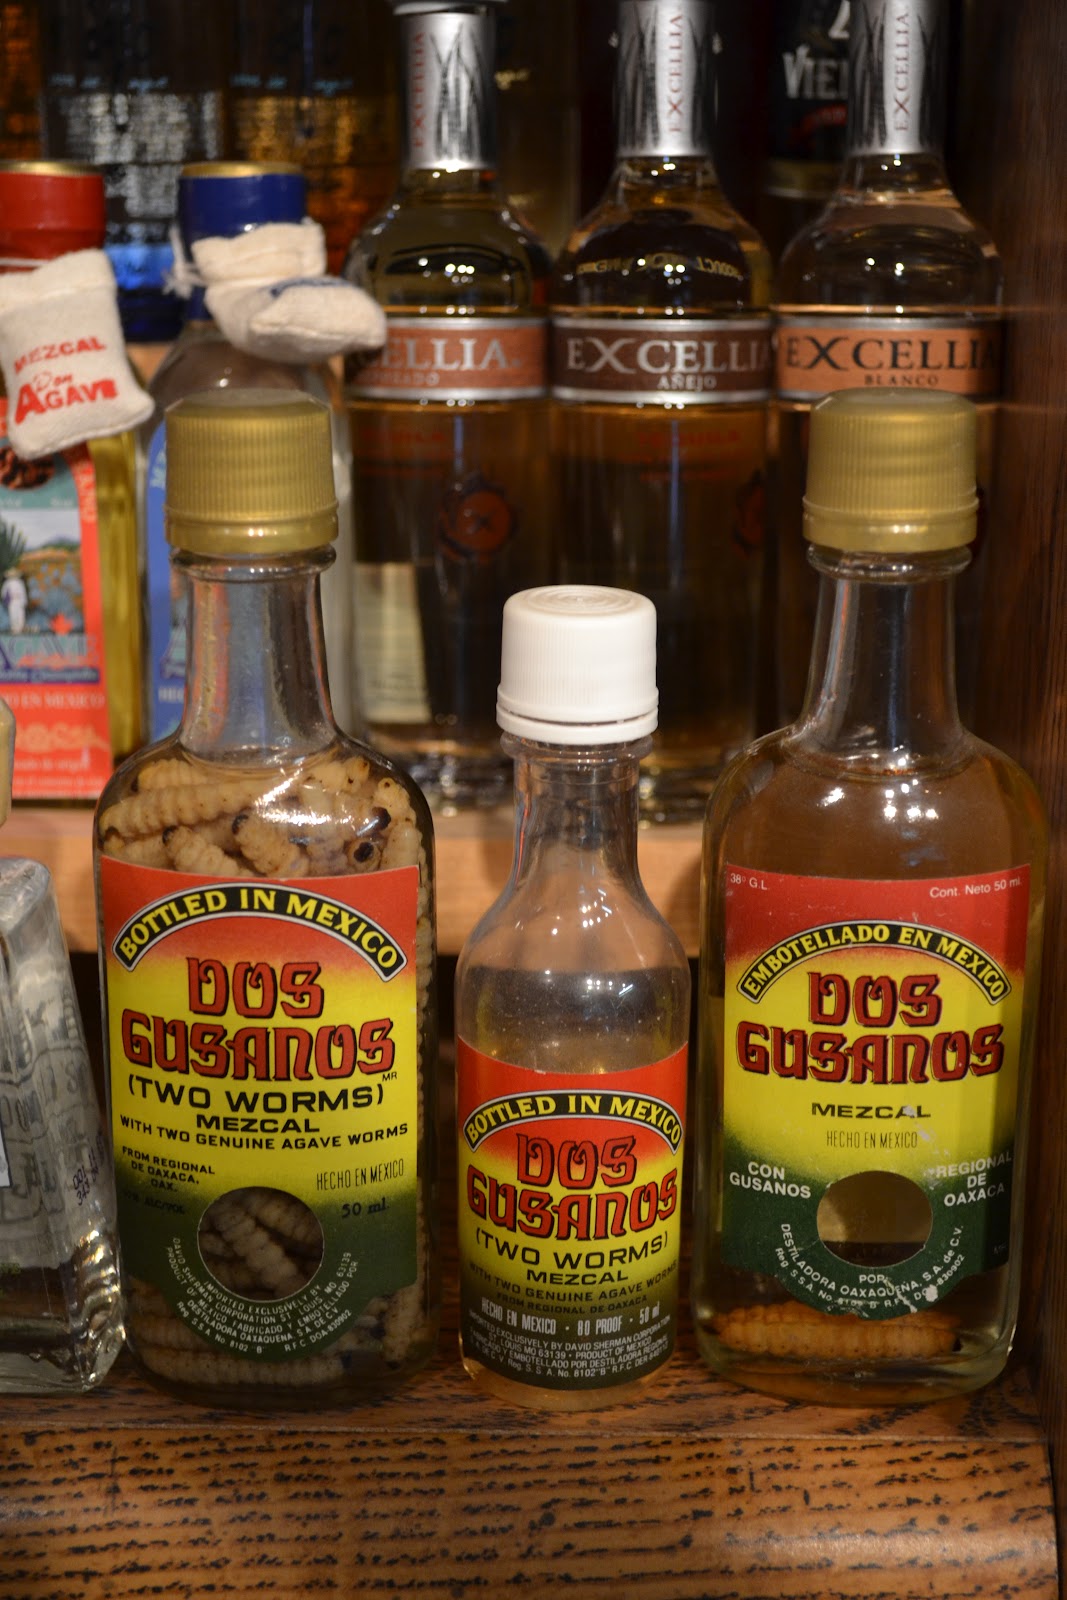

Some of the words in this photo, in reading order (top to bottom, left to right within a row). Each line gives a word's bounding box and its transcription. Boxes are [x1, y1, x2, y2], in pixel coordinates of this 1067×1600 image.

[894, 13, 911, 131] EXCELLIA
[13, 336, 107, 375] MEZCAL
[657, 372, 717, 392] AÑEJO
[864, 373, 939, 386] BLANCO
[929, 886, 961, 899] Cont.
[964, 883, 991, 895] Neto
[994, 879, 1007, 892] 50
[119, 889, 227, 961] BOTTLED
[239, 888, 277, 912] IN
[286, 893, 398, 969] MEXICO
[744, 924, 891, 996] EMBOTELLADO
[897, 927, 934, 949] EN
[938, 937, 1008, 998] MEXICO
[186, 956, 325, 1019] DOS
[808, 971, 943, 1028] DOS
[121, 1008, 396, 1082] GUSANOS
[736, 1020, 1005, 1085] GUSANOS
[128, 1073, 211, 1110] (TWO
[225, 1082, 385, 1114] WORMS)
[381, 1071, 398, 1083] MR
[196, 1114, 320, 1134] MEZCAL
[466, 1095, 557, 1144] BOTTLED
[567, 1095, 602, 1114] IN
[609, 1096, 682, 1145] MEXICO
[811, 1102, 931, 1119] MEZCAL
[120, 1114, 152, 1136] WITH
[156, 1126, 190, 1144] TWO
[199, 1133, 275, 1151] GENUINE
[281, 1135, 342, 1150] AGAVE
[347, 1122, 409, 1146] WORMS
[826, 1130, 860, 1149] HECHO
[864, 1131, 876, 1149] EN
[880, 1131, 918, 1149] MEXICO
[121, 1145, 150, 1162] FROM
[153, 1155, 216, 1175] REGIONAL
[131, 1160, 144, 1172] DE
[316, 1169, 351, 1191] HECHO
[355, 1167, 367, 1187] EN
[370, 1158, 404, 1184] MEXICO
[516, 1133, 638, 1190] DOS
[747, 1161, 786, 1181] CON
[935, 1151, 1013, 1178] REGIONAL
[729, 1171, 812, 1199] GUSANOS
[943, 1182, 1005, 1207] OAXACA
[967, 1172, 987, 1189] DE
[341, 1202, 362, 1219] 50
[467, 1164, 678, 1242] GUSANOS
[476, 1227, 540, 1266] (TWO
[553, 1230, 669, 1270] WORMS)
[781, 1223, 836, 1291] DESTILADORA
[943, 1248, 955, 1264] de
[166, 1246, 188, 1285] PRODUCT
[186, 1286, 198, 1297] OF
[198, 1298, 228, 1323] MEXICO
[232, 1320, 283, 1335] FABRICADO
[297, 1280, 351, 1328] EMBOTELLADO
[347, 1261, 359, 1279] POR
[172, 1237, 186, 1265] DAVID
[182, 1266, 214, 1303] SHERMAN
[215, 1302, 276, 1325] CORPORATION
[298, 1295, 323, 1316] LOUIS
[324, 1281, 337, 1294] MO
[336, 1251, 352, 1278] 63139
[494, 1275, 521, 1295] TWO
[525, 1287, 593, 1302] GENUINE
[598, 1281, 643, 1300] AGAVE
[646, 1259, 677, 1288] WORMS
[526, 1269, 629, 1286] MEZCAL
[858, 1274, 885, 1284] POR
[914, 1254, 965, 1301] DO-830902
[203, 1280, 245, 1311] IMPORTED
[248, 1294, 308, 1316] EXCLUSIVELY
[310, 1284, 322, 1297] BY
[497, 1292, 524, 1307] FROM
[527, 1302, 585, 1315] REGIONAL
[590, 1304, 605, 1314] DE
[607, 1294, 648, 1311] OAXACA
[187, 1299, 238, 1338] DESTILADORA
[481, 1296, 503, 1321] HECHO
[506, 1309, 518, 1327] EN
[521, 1313, 557, 1335] MEXICO
[595, 1314, 623, 1335] PROOF
[229, 1340, 249, 1353] 8102
[496, 1326, 549, 1349] EXCLUSIVELY
[550, 1341, 562, 1351] BY
[565, 1341, 592, 1351] DAVID
[593, 1335, 632, 1349] SHERMAN
[500, 1338, 522, 1352] LOUIS
[523, 1346, 537, 1356] MO
[538, 1350, 566, 1359] 63139
[575, 1348, 613, 1360] PRODUCT
[614, 1344, 625, 1352] OF
[626, 1335, 652, 1352] MEXICO
[502, 1347, 508, 1356] Y
[509, 1350, 569, 1369] EMBOTELLADO
[571, 1360, 588, 1369] POR
[589, 1350, 642, 1368] DESTILADORA
